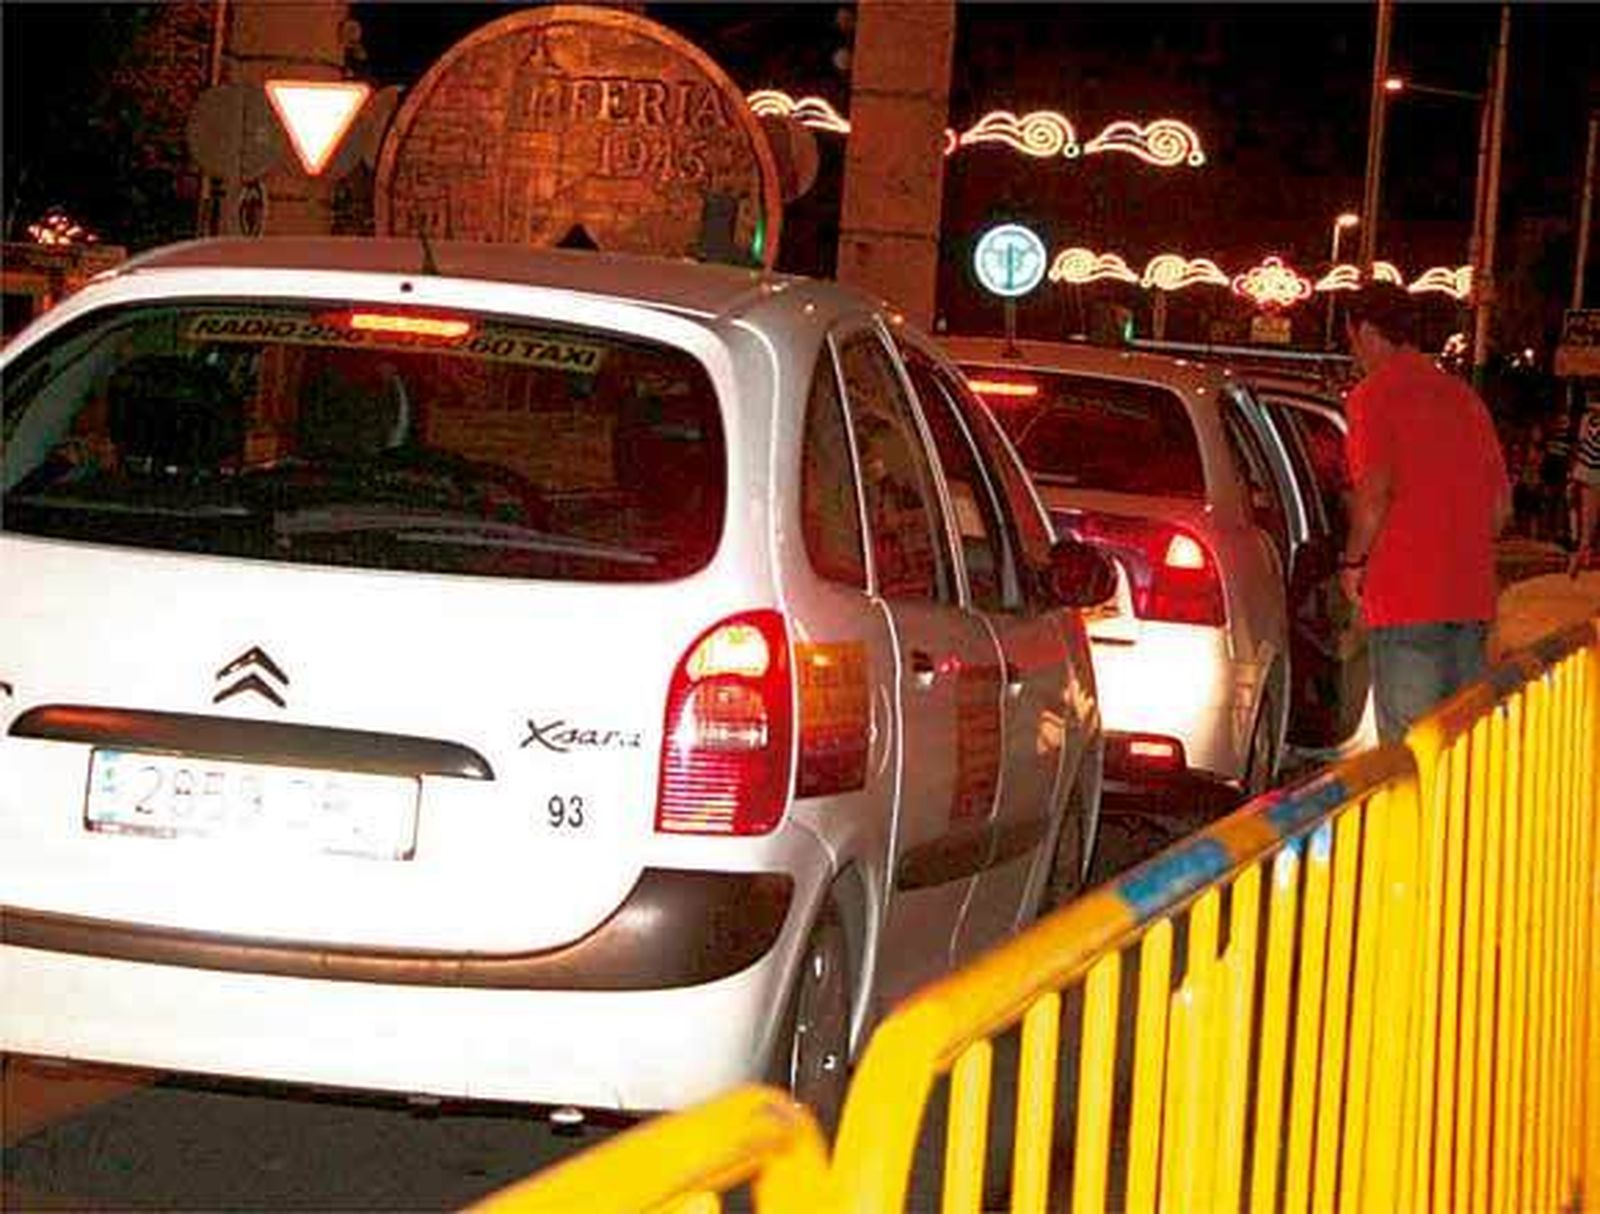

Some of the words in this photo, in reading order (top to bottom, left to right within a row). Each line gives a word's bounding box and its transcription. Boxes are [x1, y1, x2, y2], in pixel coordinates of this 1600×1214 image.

[569, 78, 734, 128] FERIA
[195, 316, 298, 337] RADIO
[521, 341, 597, 367] TAXI
[548, 794, 584, 828] 93
